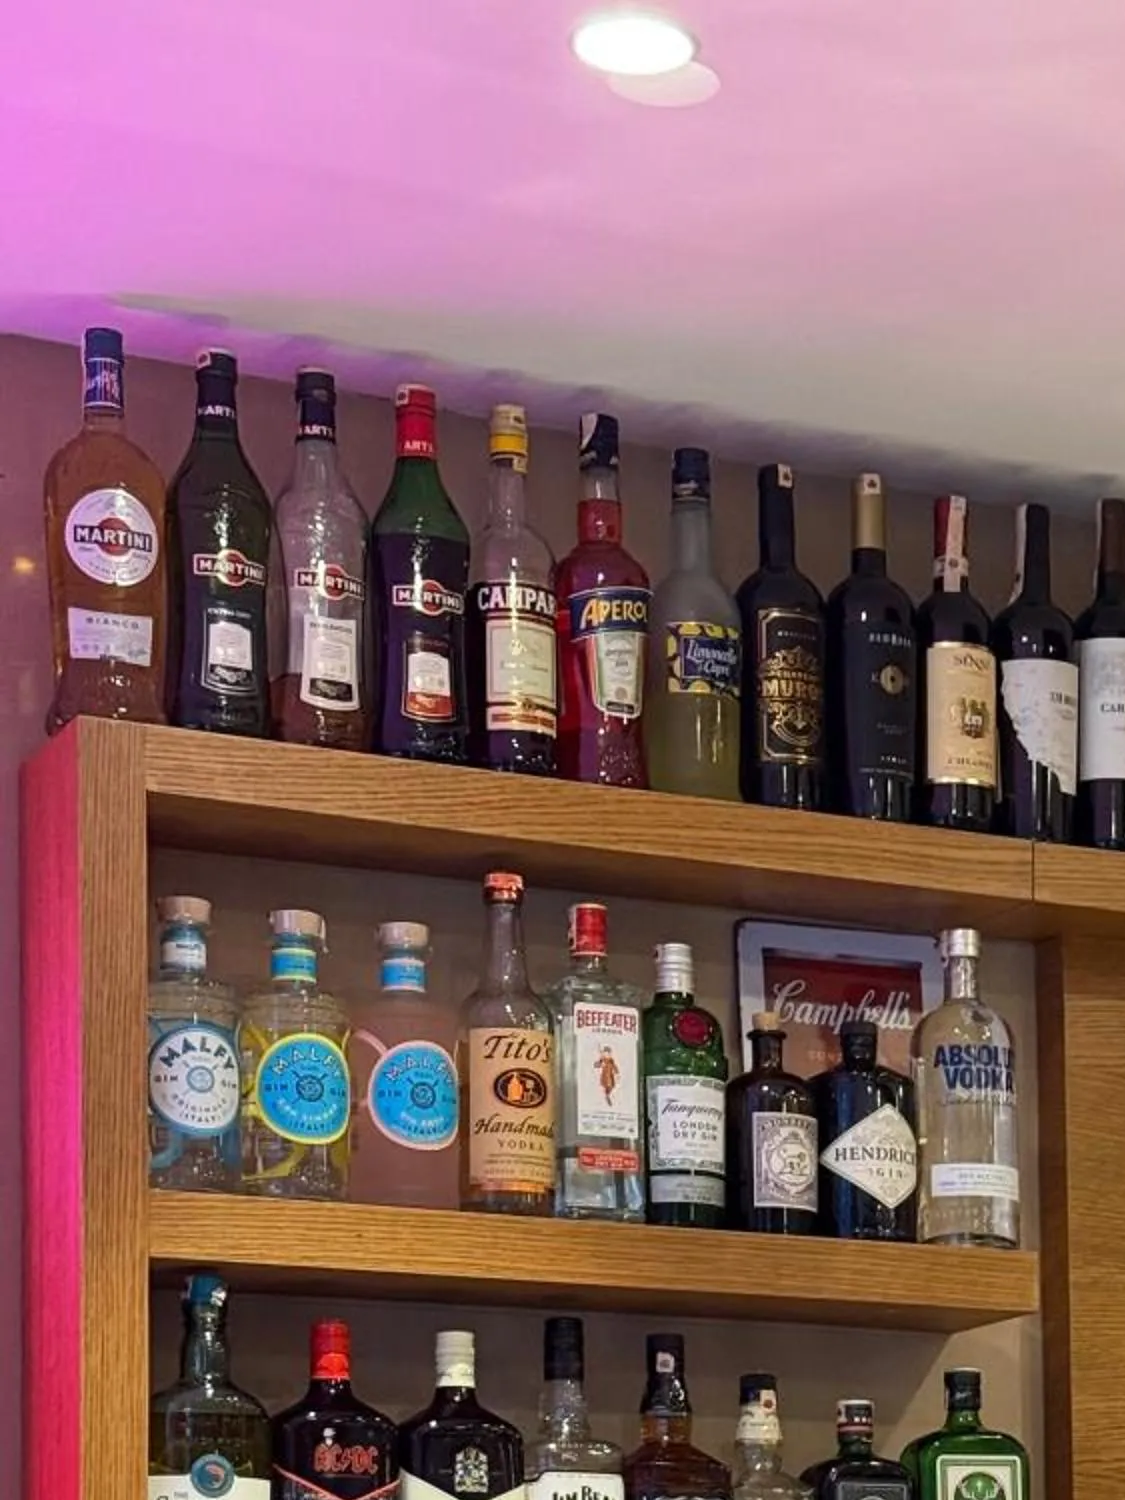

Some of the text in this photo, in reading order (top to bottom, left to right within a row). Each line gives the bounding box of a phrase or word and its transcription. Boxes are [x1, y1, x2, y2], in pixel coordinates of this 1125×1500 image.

[76, 526, 151, 550] MARTINI
[200, 559, 264, 580] MARTINI
[300, 572, 361, 594] MARTINI
[399, 590, 459, 608] MARTINI
[773, 980, 915, 1035] Campbell's
[576, 1009, 637, 1035] BEEFEATER
[159, 1035, 235, 1070] MALFY
[484, 1033, 551, 1064] Tito's
[934, 1045, 1013, 1070] ABSOLU
[944, 1065, 1013, 1094] VODKA
[672, 1121, 718, 1132] LONDON
[672, 1130, 696, 1140] DRY
[498, 1139, 545, 1151] VODKA
[835, 1147, 916, 1166] HENDRIC
